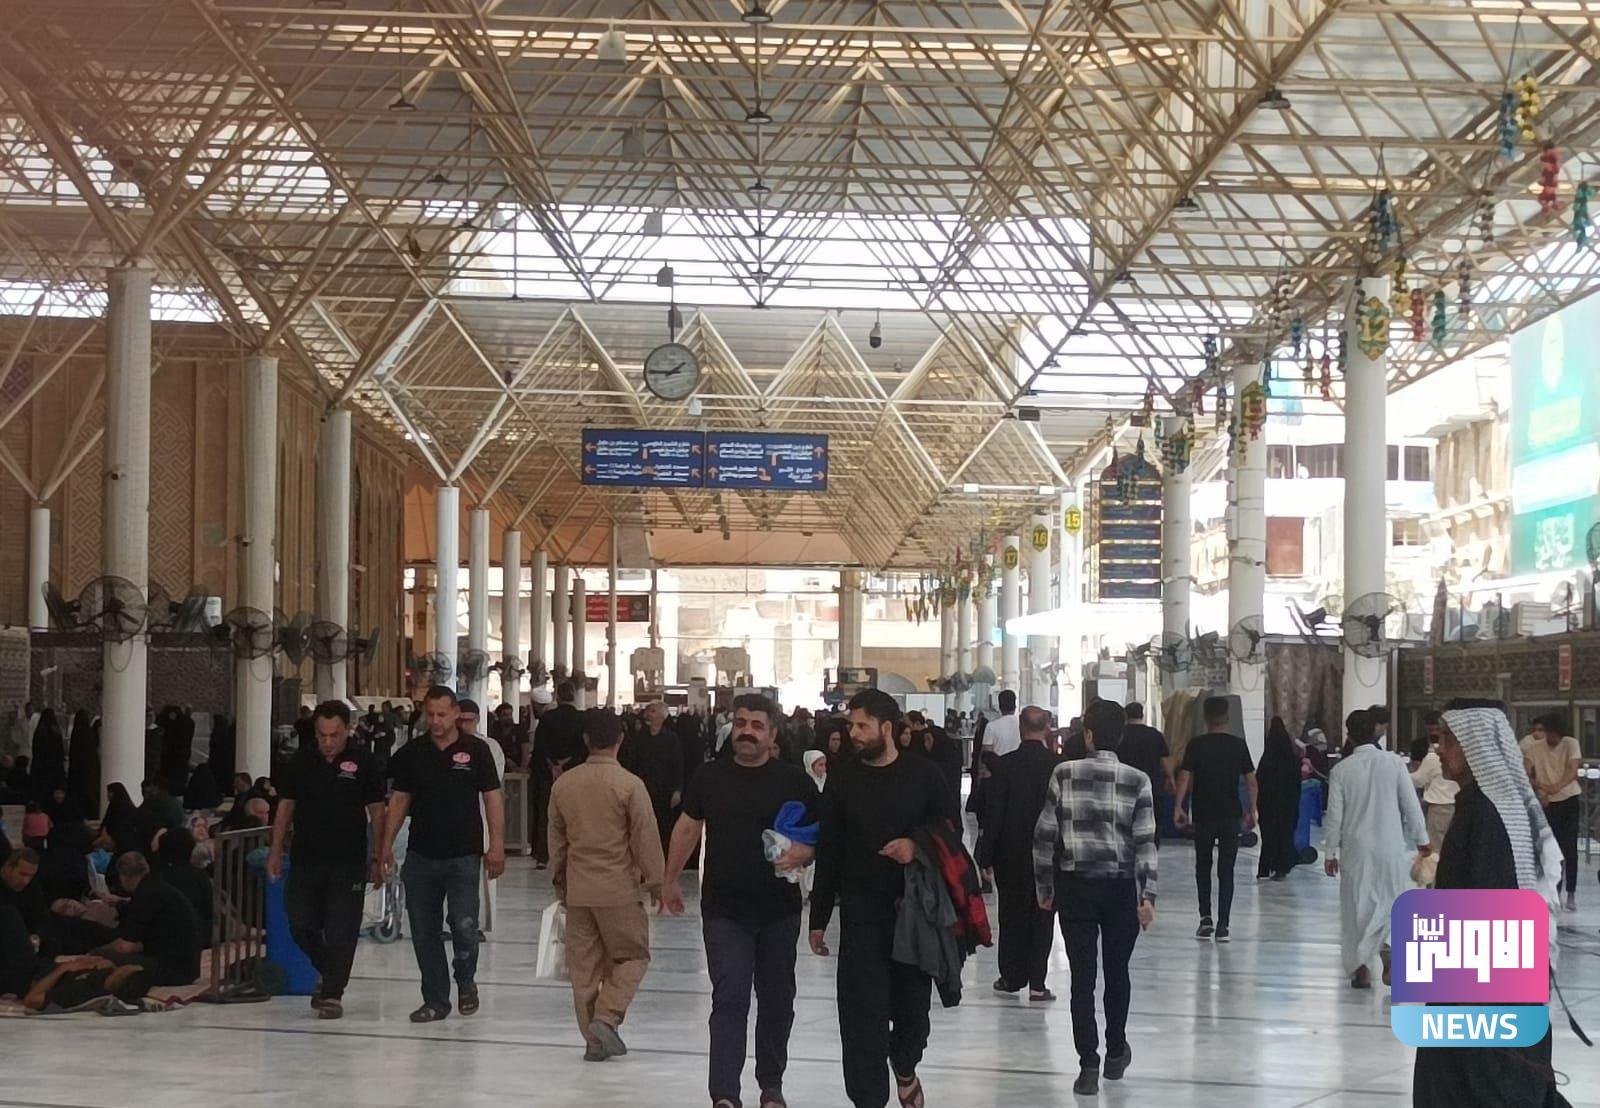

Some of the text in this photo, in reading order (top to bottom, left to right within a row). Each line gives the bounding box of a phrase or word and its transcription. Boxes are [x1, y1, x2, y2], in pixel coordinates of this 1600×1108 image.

[1362, 316, 1388, 343] 12
[1066, 513, 1080, 528] 15
[1034, 532, 1047, 544] 16
